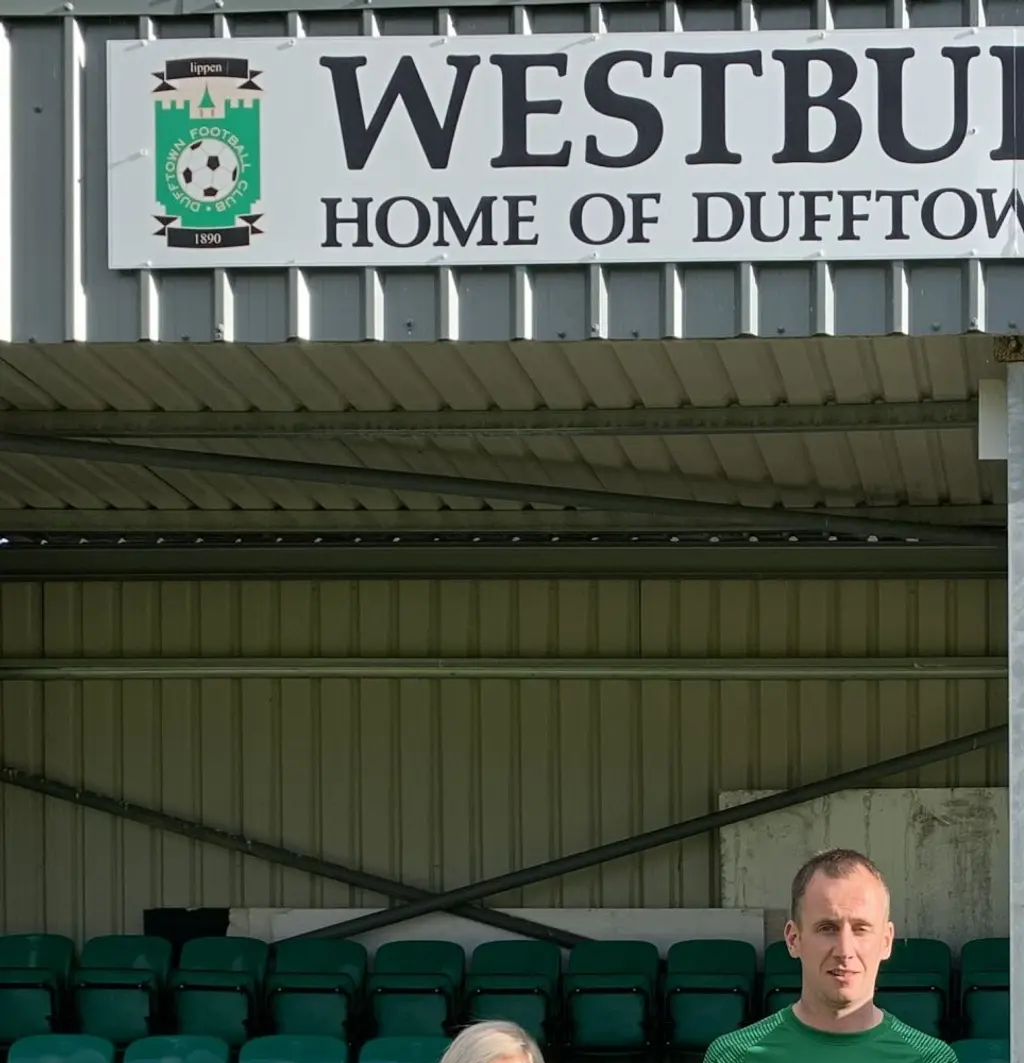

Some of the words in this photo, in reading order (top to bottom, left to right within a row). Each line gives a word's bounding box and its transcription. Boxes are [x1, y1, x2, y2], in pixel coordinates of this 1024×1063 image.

[190, 62, 222, 76] lippen
[189, 126, 252, 173] FOOTBALL
[165, 138, 201, 212] DUFFTOWN
[215, 180, 248, 212] CLUB
[194, 233, 222, 244] 1890
[321, 196, 538, 247] HOME
[570, 193, 660, 245] OF
